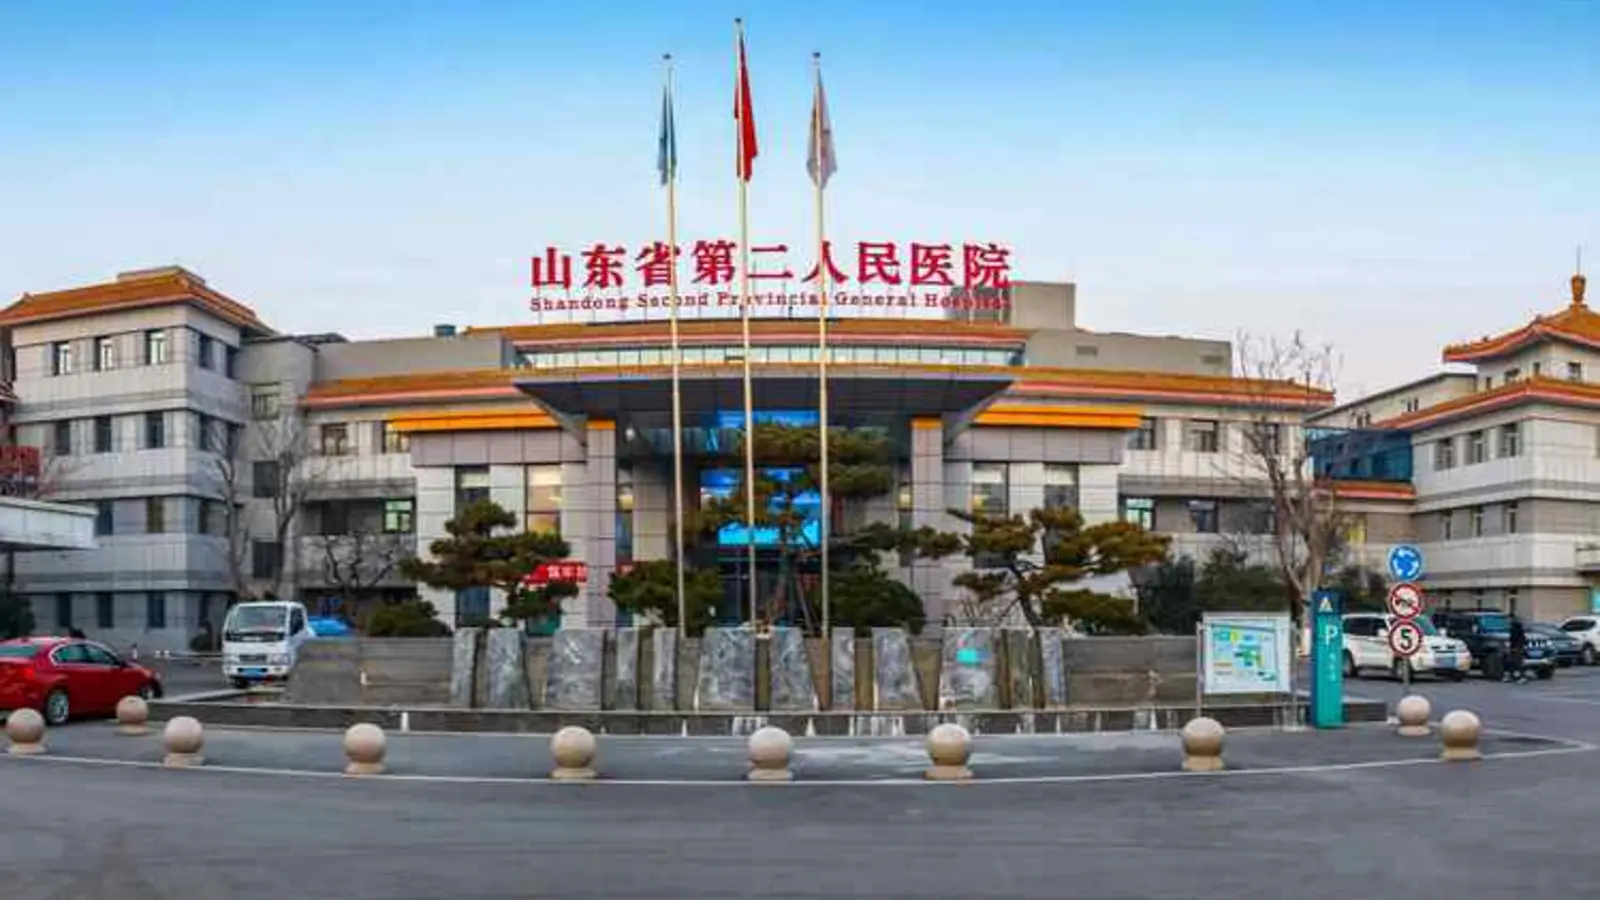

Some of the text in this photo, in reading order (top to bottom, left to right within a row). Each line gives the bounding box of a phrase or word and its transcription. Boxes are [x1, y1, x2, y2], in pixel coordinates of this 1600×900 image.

[531, 240, 1009, 290] 山东省第二人民医院
[530, 297, 629, 311] Shandong
[637, 293, 709, 308] Second
[835, 291, 916, 307] General
[1325, 625, 1338, 645] P
[1400, 629, 1412, 649] 5
